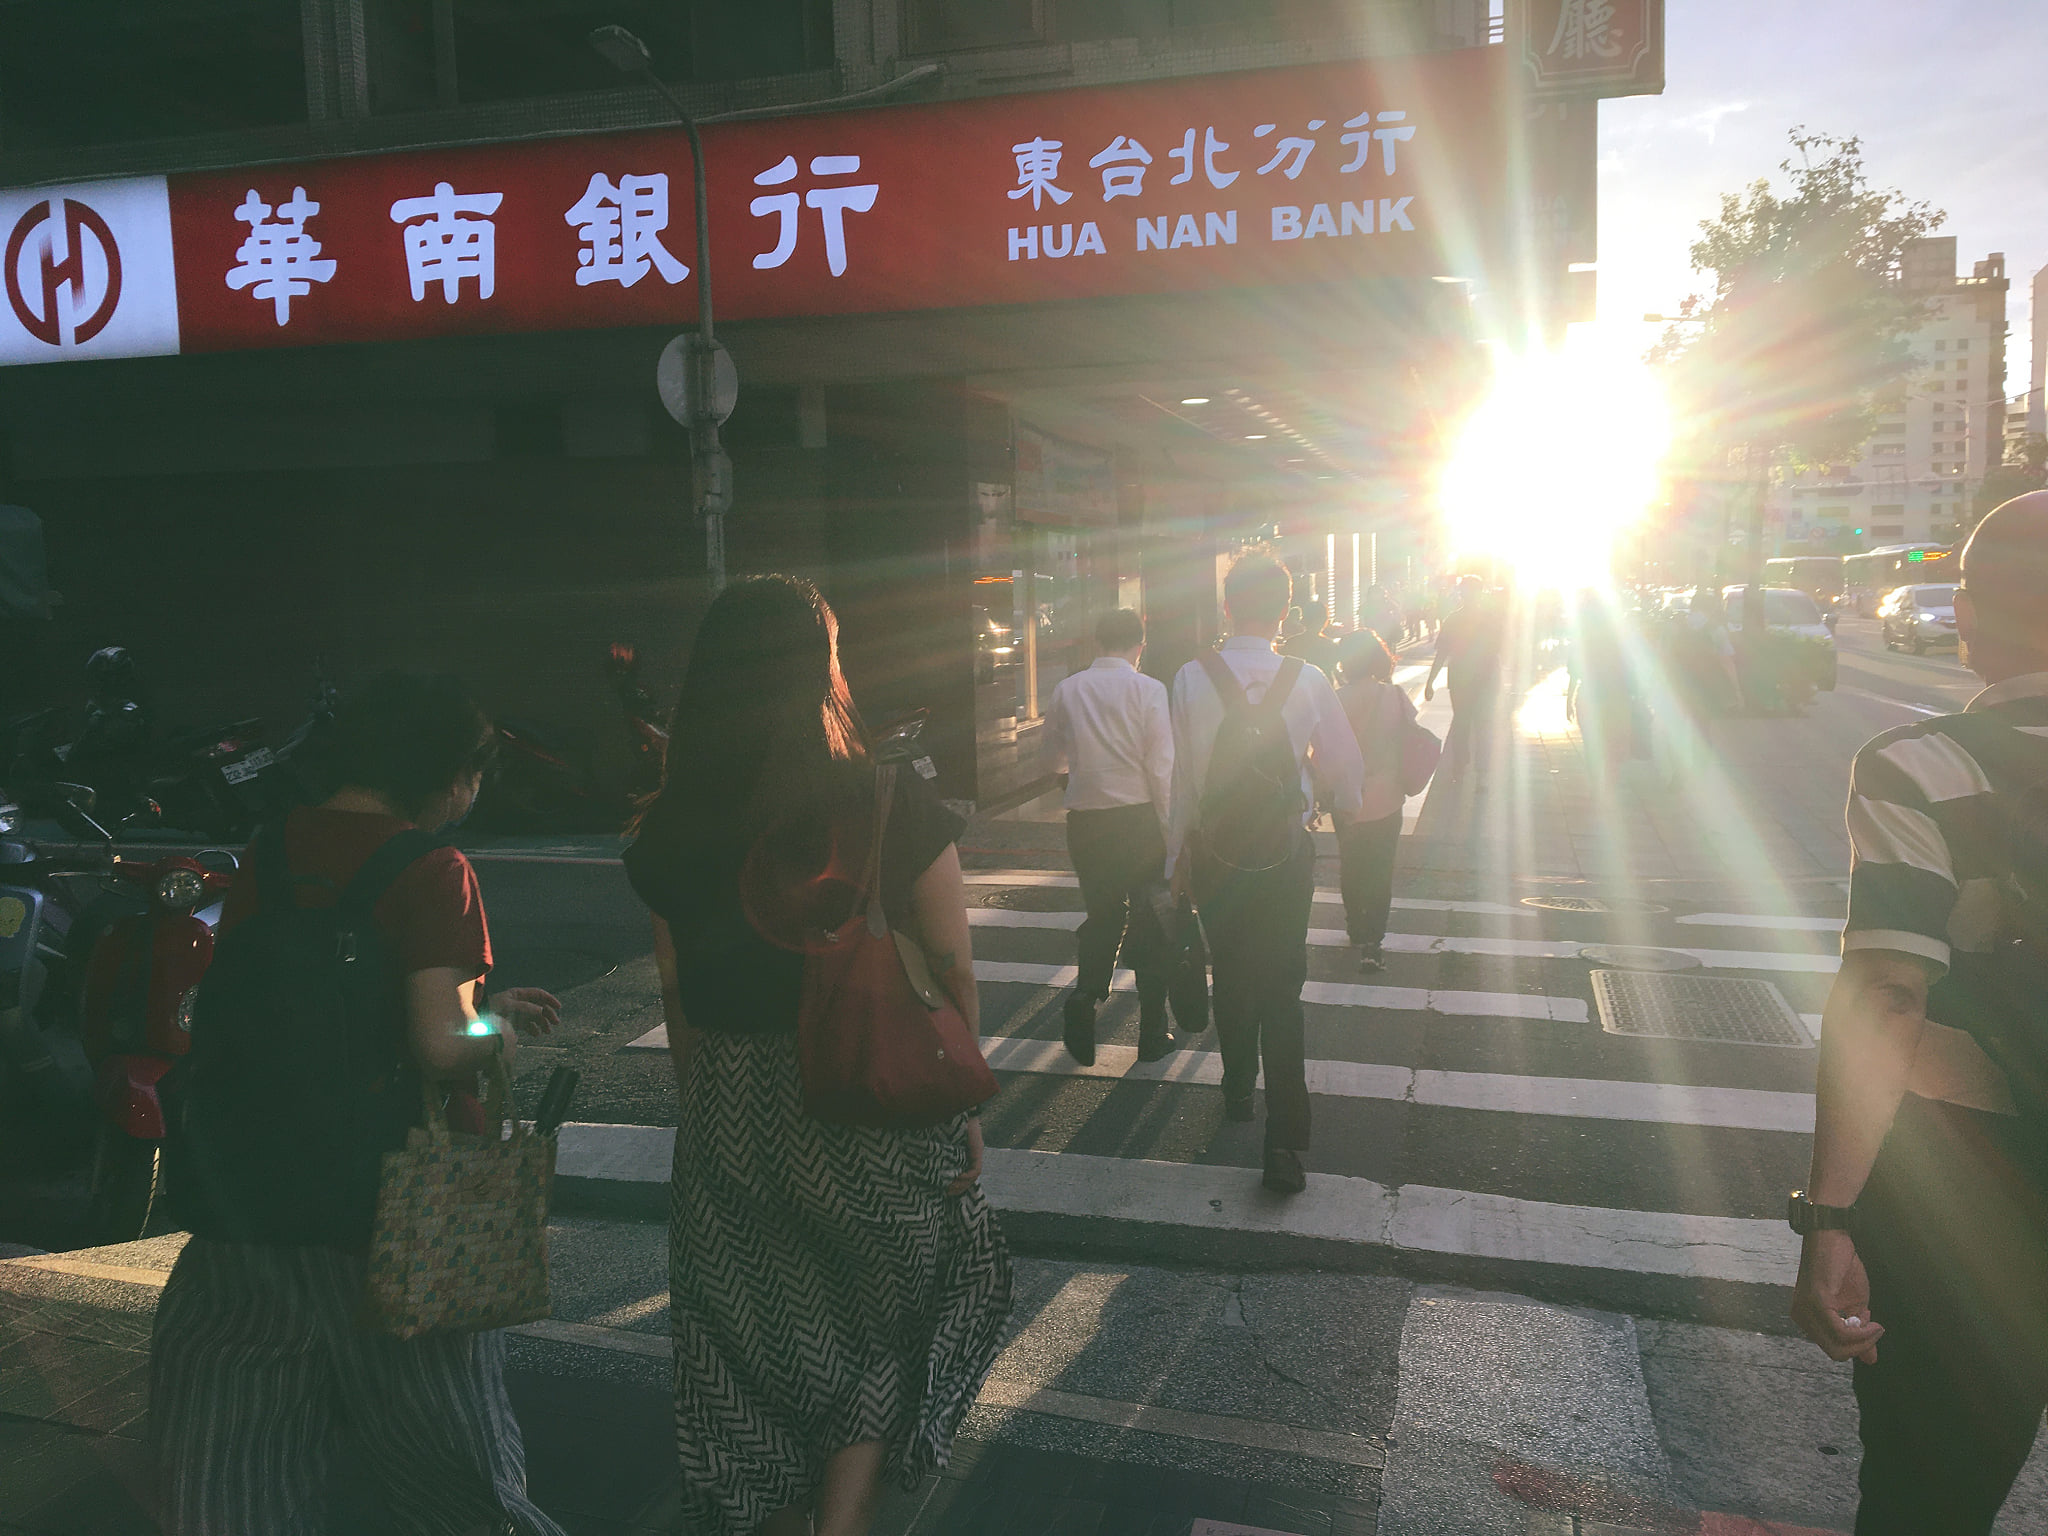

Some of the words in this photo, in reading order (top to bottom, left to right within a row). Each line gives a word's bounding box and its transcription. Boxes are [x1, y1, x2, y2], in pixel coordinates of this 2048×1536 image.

[1007, 111, 1417, 211] 東台北分行
[225, 156, 880, 326] 華南銀行
[1008, 222, 1107, 261] HUA
[1135, 210, 1238, 252] NAN
[1271, 196, 1415, 241] BANK
